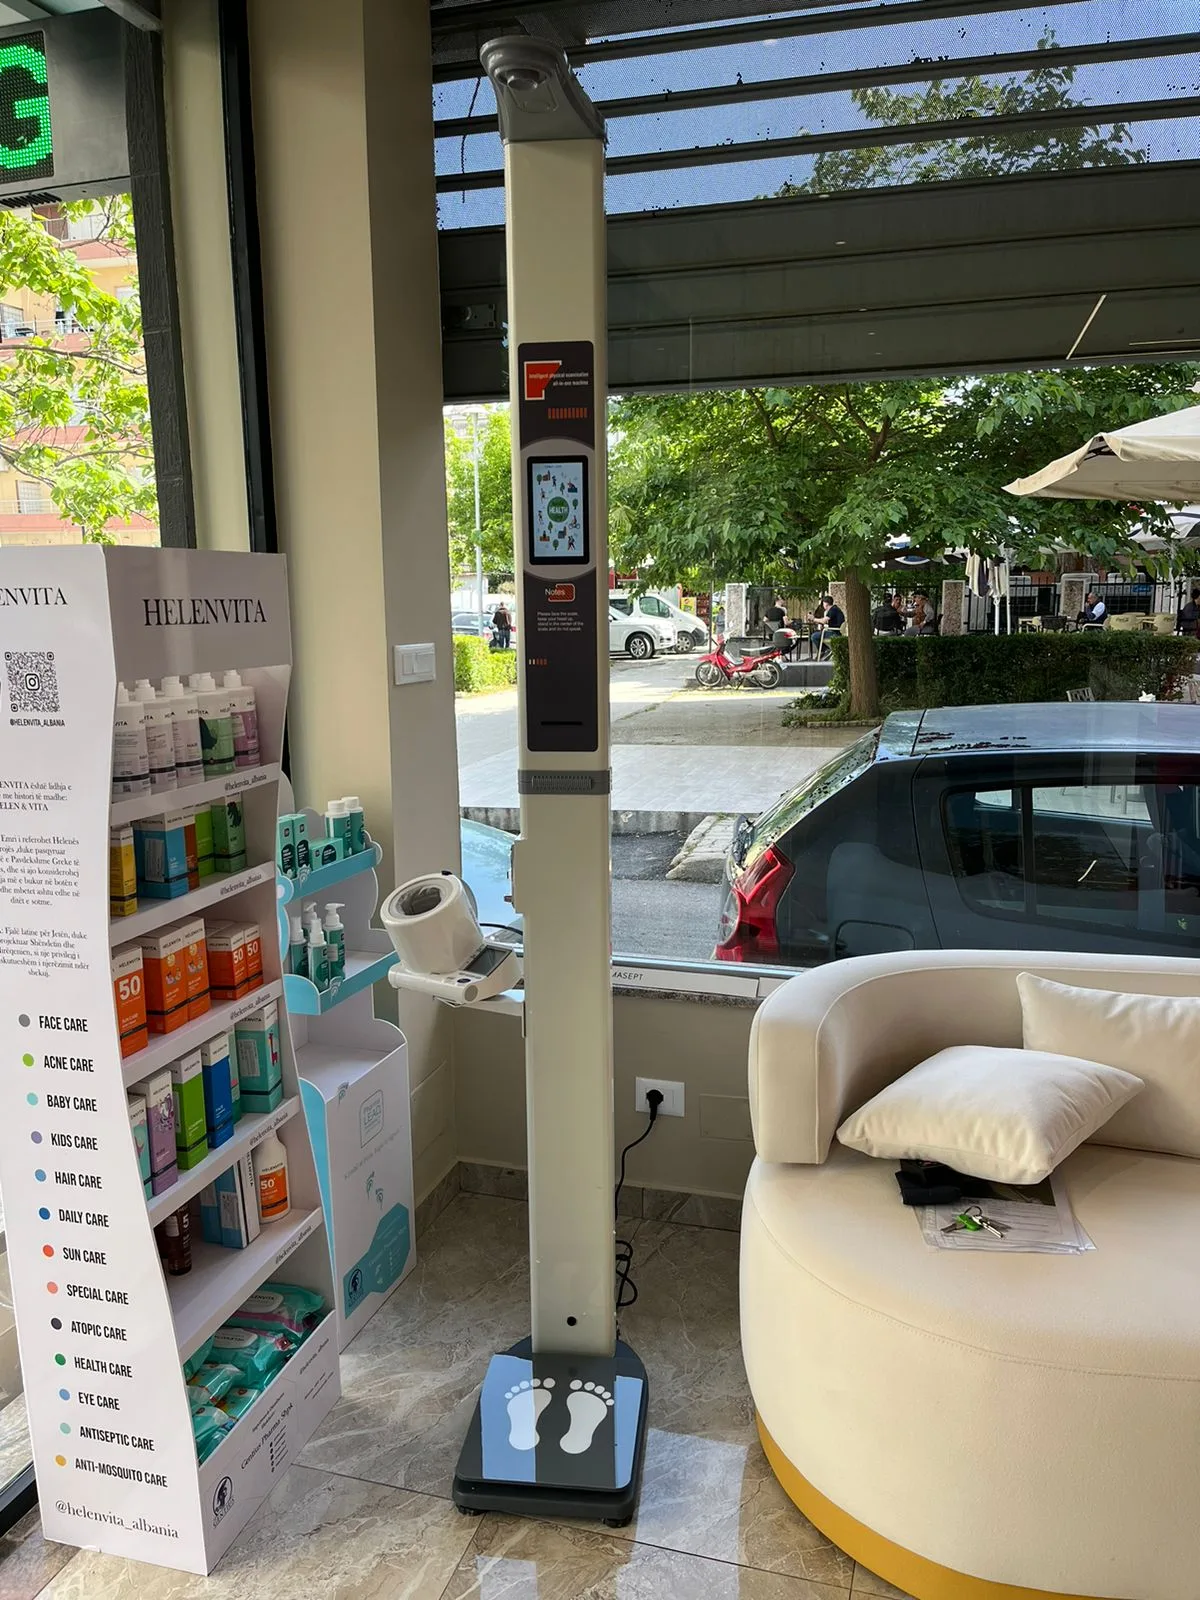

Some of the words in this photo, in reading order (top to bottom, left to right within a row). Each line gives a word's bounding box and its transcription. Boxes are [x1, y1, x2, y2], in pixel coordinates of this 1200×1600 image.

[545, 588, 566, 596] Notes
[142, 598, 267, 626] HELENVITA
[10, 718, 65, 728] @HELENVITA_ALBANIA
[48, 782, 66, 792] lidhja
[28, 802, 48, 811] VITA
[233, 949, 244, 964] 50
[247, 941, 259, 956] 50
[119, 975, 141, 1000] 50
[39, 1016, 61, 1030] FACE
[64, 1017, 88, 1032] CARE
[44, 1056, 68, 1070] ACNE
[70, 1058, 94, 1072] CARE
[47, 1094, 70, 1109] BABY
[73, 1097, 97, 1112] CARE
[51, 1133, 72, 1148] KIDS
[75, 1136, 98, 1151] CARE
[55, 1172, 77, 1186] HAIR
[78, 1174, 102, 1189] CARE
[59, 1208, 83, 1225] DAILY
[85, 1212, 109, 1227] CARE
[63, 1247, 81, 1262] SUN
[83, 1249, 106, 1265] CARE
[67, 1284, 103, 1301] SPECIAL
[105, 1289, 129, 1305] CARE
[71, 1321, 101, 1337] ATOPIC
[104, 1325, 127, 1341] CARE
[74, 1356, 107, 1374] HEALTH
[109, 1362, 133, 1378] CARE
[78, 1392, 95, 1406] EYE
[97, 1395, 120, 1411] CARE
[80, 1426, 130, 1446] ANTISEPTIC
[131, 1436, 155, 1451] CARE
[241, 1444, 261, 1470] Gentius
[262, 1420, 280, 1444] Pharma
[75, 1458, 143, 1483] ANTI-MOSQUITO
[144, 1472, 168, 1488] CARE
[55, 1500, 179, 1540] @helenvita_albania
